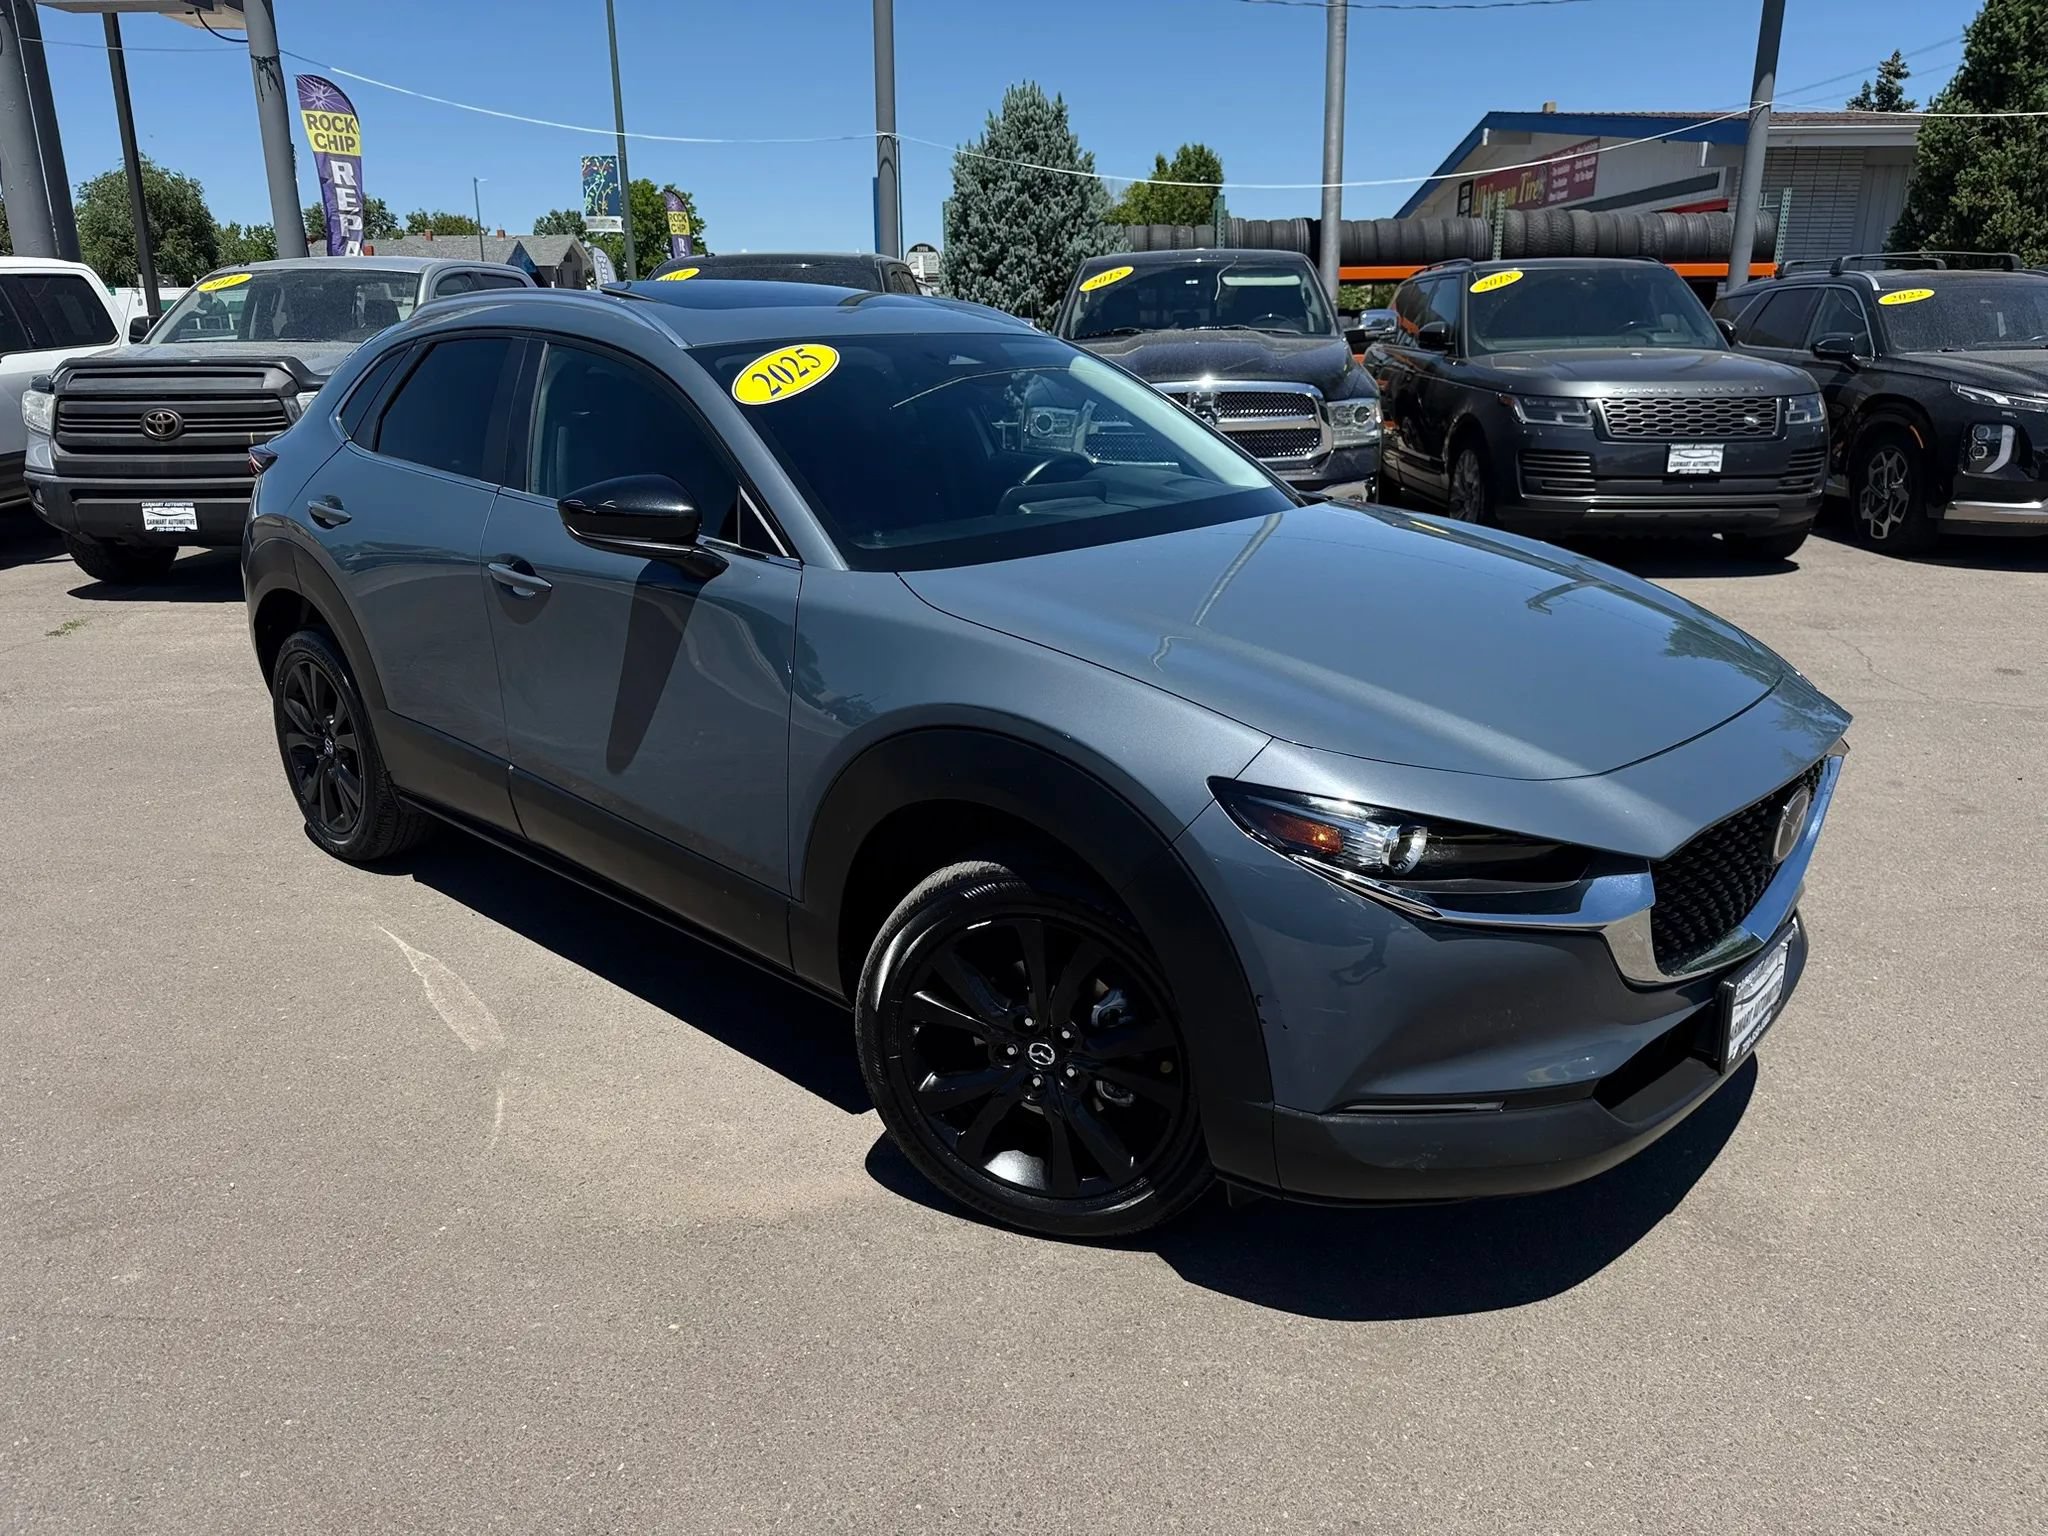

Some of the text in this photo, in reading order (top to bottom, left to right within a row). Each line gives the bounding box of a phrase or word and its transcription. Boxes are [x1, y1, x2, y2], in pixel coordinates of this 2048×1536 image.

[304, 113, 357, 135] ROCK
[313, 132, 356, 152] CHIP
[668, 212, 688, 223] ROCK
[1481, 271, 1513, 289] 2018
[1890, 290, 1924, 303] 2022
[751, 348, 821, 396] 2025
[168, 518, 196, 526] AUTOMOTIVE
